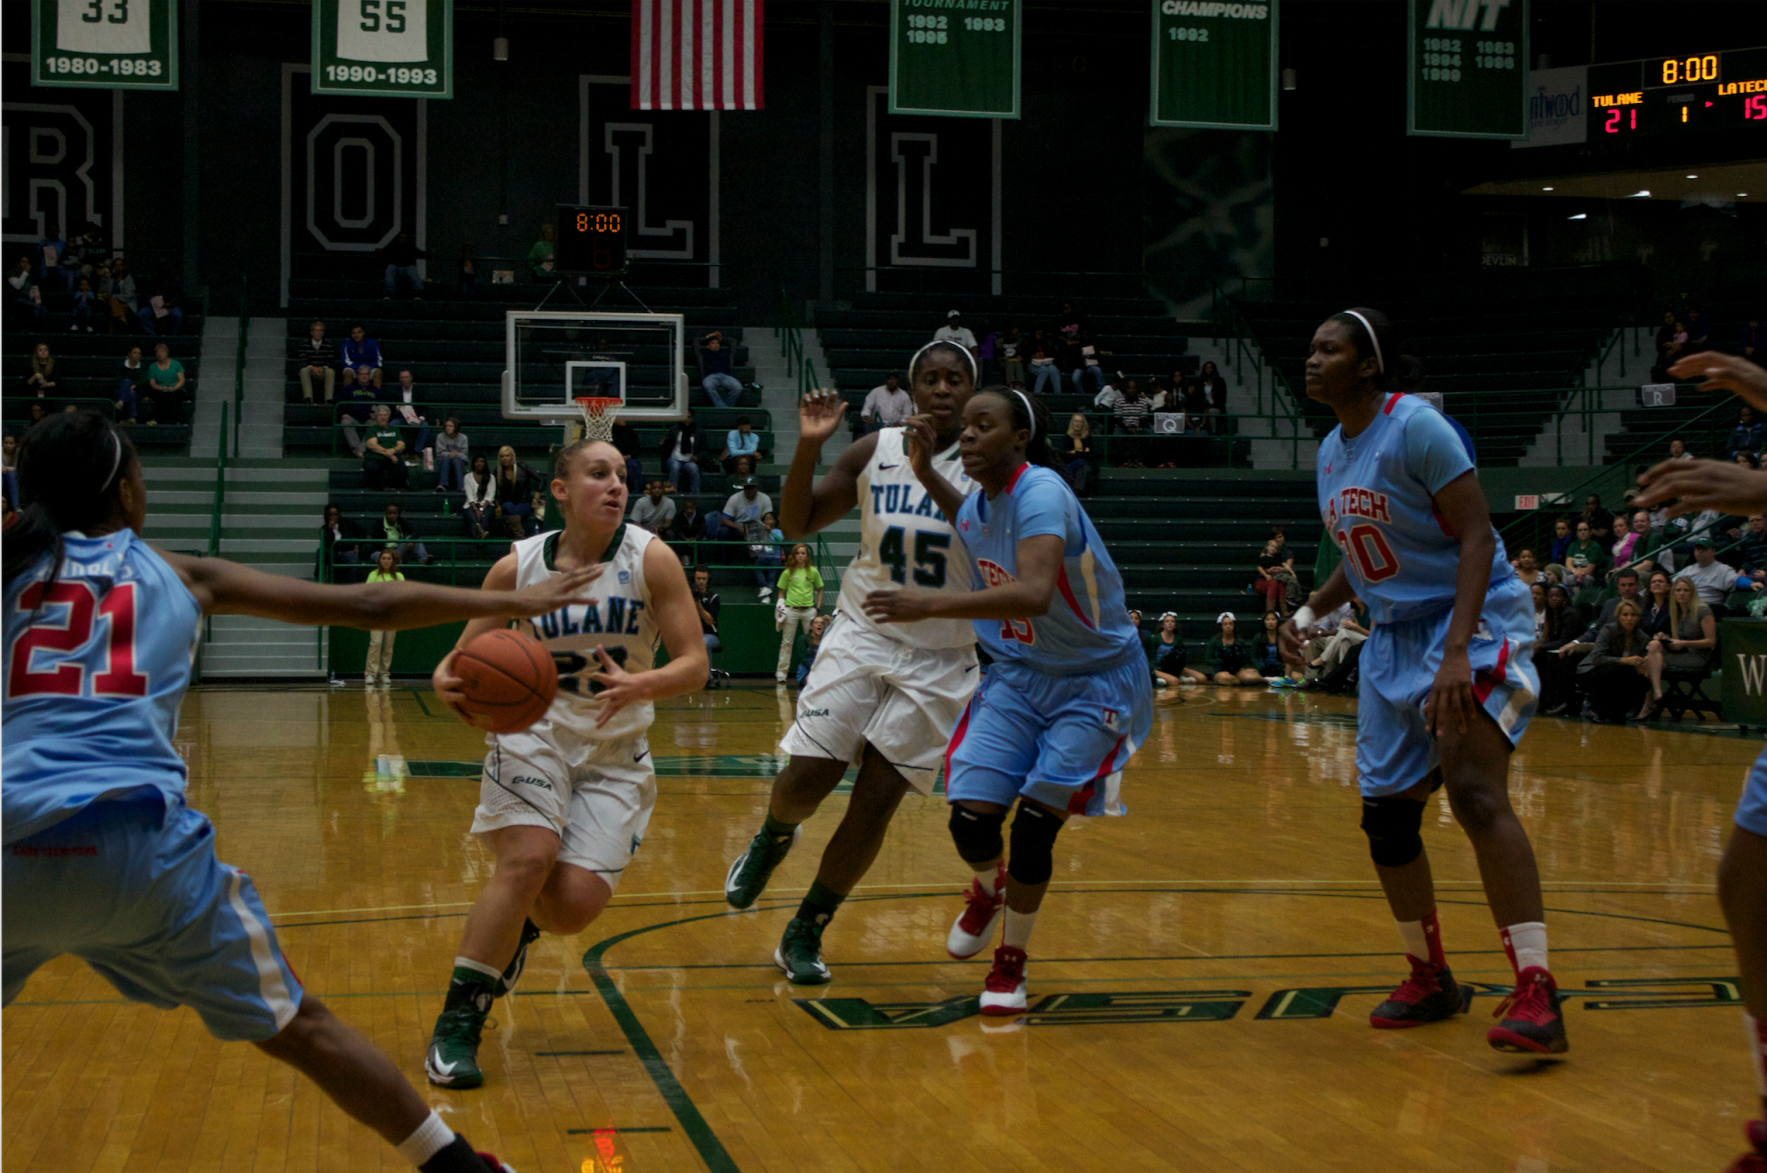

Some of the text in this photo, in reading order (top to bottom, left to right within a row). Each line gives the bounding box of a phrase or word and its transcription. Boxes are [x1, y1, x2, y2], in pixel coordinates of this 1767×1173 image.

[82, 0, 128, 24] 33
[360, 0, 407, 33] 55
[1162, 0, 1268, 20] CHAMPIONS
[1426, 0, 1511, 32] NIT
[907, 14, 1006, 32] 1992 1993
[1168, 27, 1209, 42] 1992
[46, 57, 162, 77] 1980-1983
[326, 65, 438, 85] 1990-1993
[1663, 56, 1718, 84] 8:00
[1592, 92, 1643, 108] TULANE
[1744, 94, 1767, 120] 15
[1605, 109, 1637, 134] 21
[1681, 106, 1688, 123] 1
[576, 213, 621, 233] 8:00
[1653, 391, 1663, 405] R
[1162, 418, 1177, 433] Q
[870, 484, 949, 522] TULA
[1340, 487, 1393, 525] TECH
[1519, 495, 1535, 509] EXIT
[879, 525, 951, 589] 45
[6, 578, 149, 701] 21
